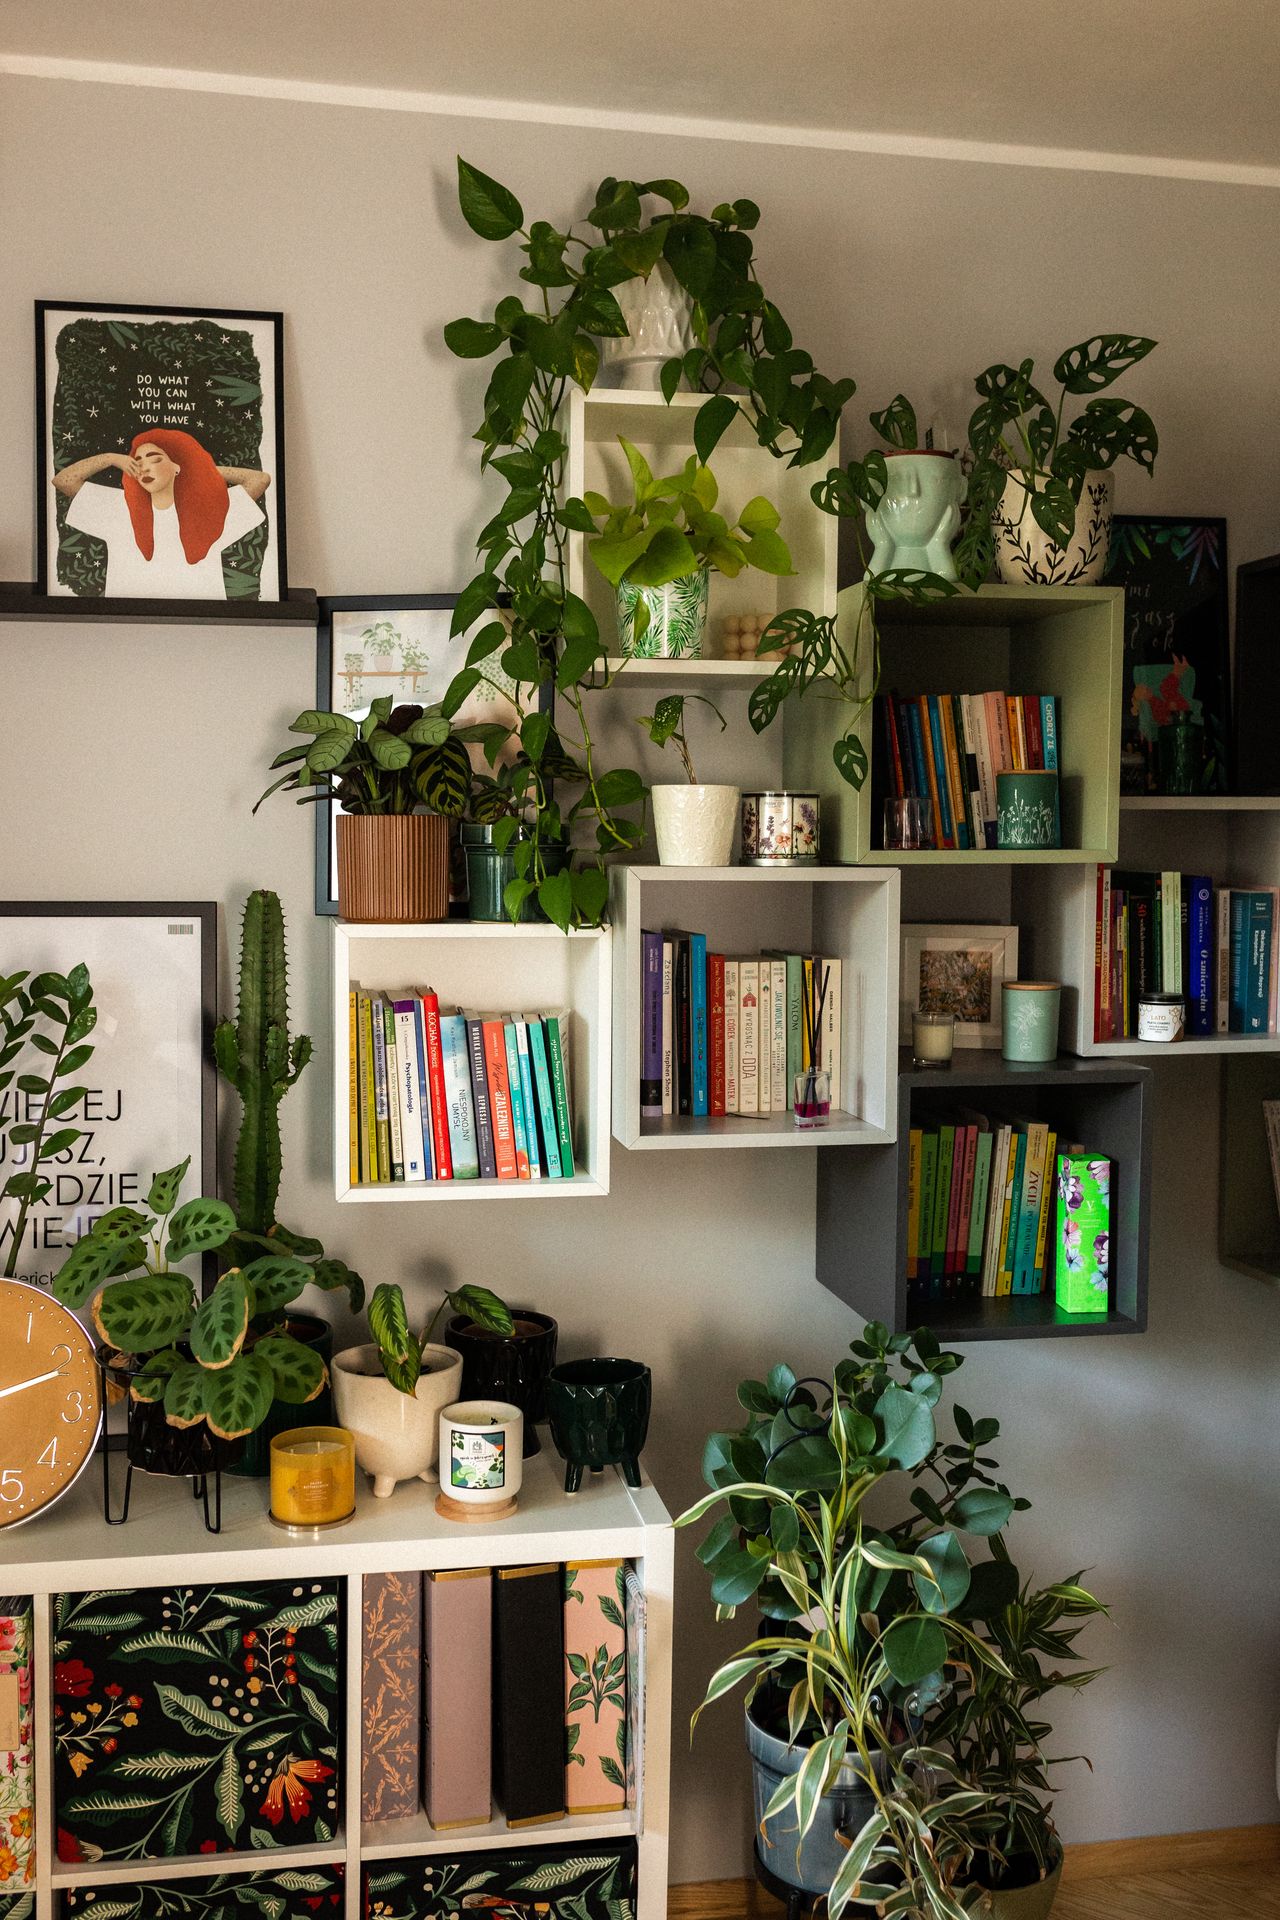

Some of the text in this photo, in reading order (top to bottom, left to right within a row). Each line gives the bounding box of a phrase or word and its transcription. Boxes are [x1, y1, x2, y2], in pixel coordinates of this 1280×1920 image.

[137, 374, 190, 386] DO WHAT
[138, 387, 187, 398] YOU CAN
[130, 400, 196, 411] WITH WHAT
[139, 414, 189, 425] YOU HAVE
[1046, 703, 1054, 738] CHORZY
[1048, 739, 1054, 750] ZE
[664, 959, 671, 969] Za
[1200, 959, 1208, 1012] zmierzchu
[400, 1015, 409, 1023] 15
[428, 1011, 438, 1046] KOCHAJ
[727, 1018, 736, 1040] CÓREK
[744, 1011, 753, 1049] WYROSNĄĆ
[773, 990, 784, 1041] JAK UWOLNIĆ SIĘ
[791, 997, 799, 1031] YALOM
[375, 1045, 383, 1063] rozwój
[472, 1026, 484, 1082] MONIKA KOTLAREK
[742, 1057, 757, 1079] DDA
[405, 1062, 414, 1114] Psychopatologia
[727, 1077, 735, 1098] MATEK
[452, 1103, 460, 1130] UMYSŁ
[459, 1089, 470, 1142] NIESPOKOJNY
[478, 1095, 487, 1125] DEPRESJA
[1026, 1170, 1041, 1207] ŻYCIE
[26, 1311, 33, 1344] 1
[51, 1343, 73, 1376] 2
[61, 1390, 83, 1424] 3
[36, 1436, 60, 1469] 4
[0, 1469, 24, 1502] 5
